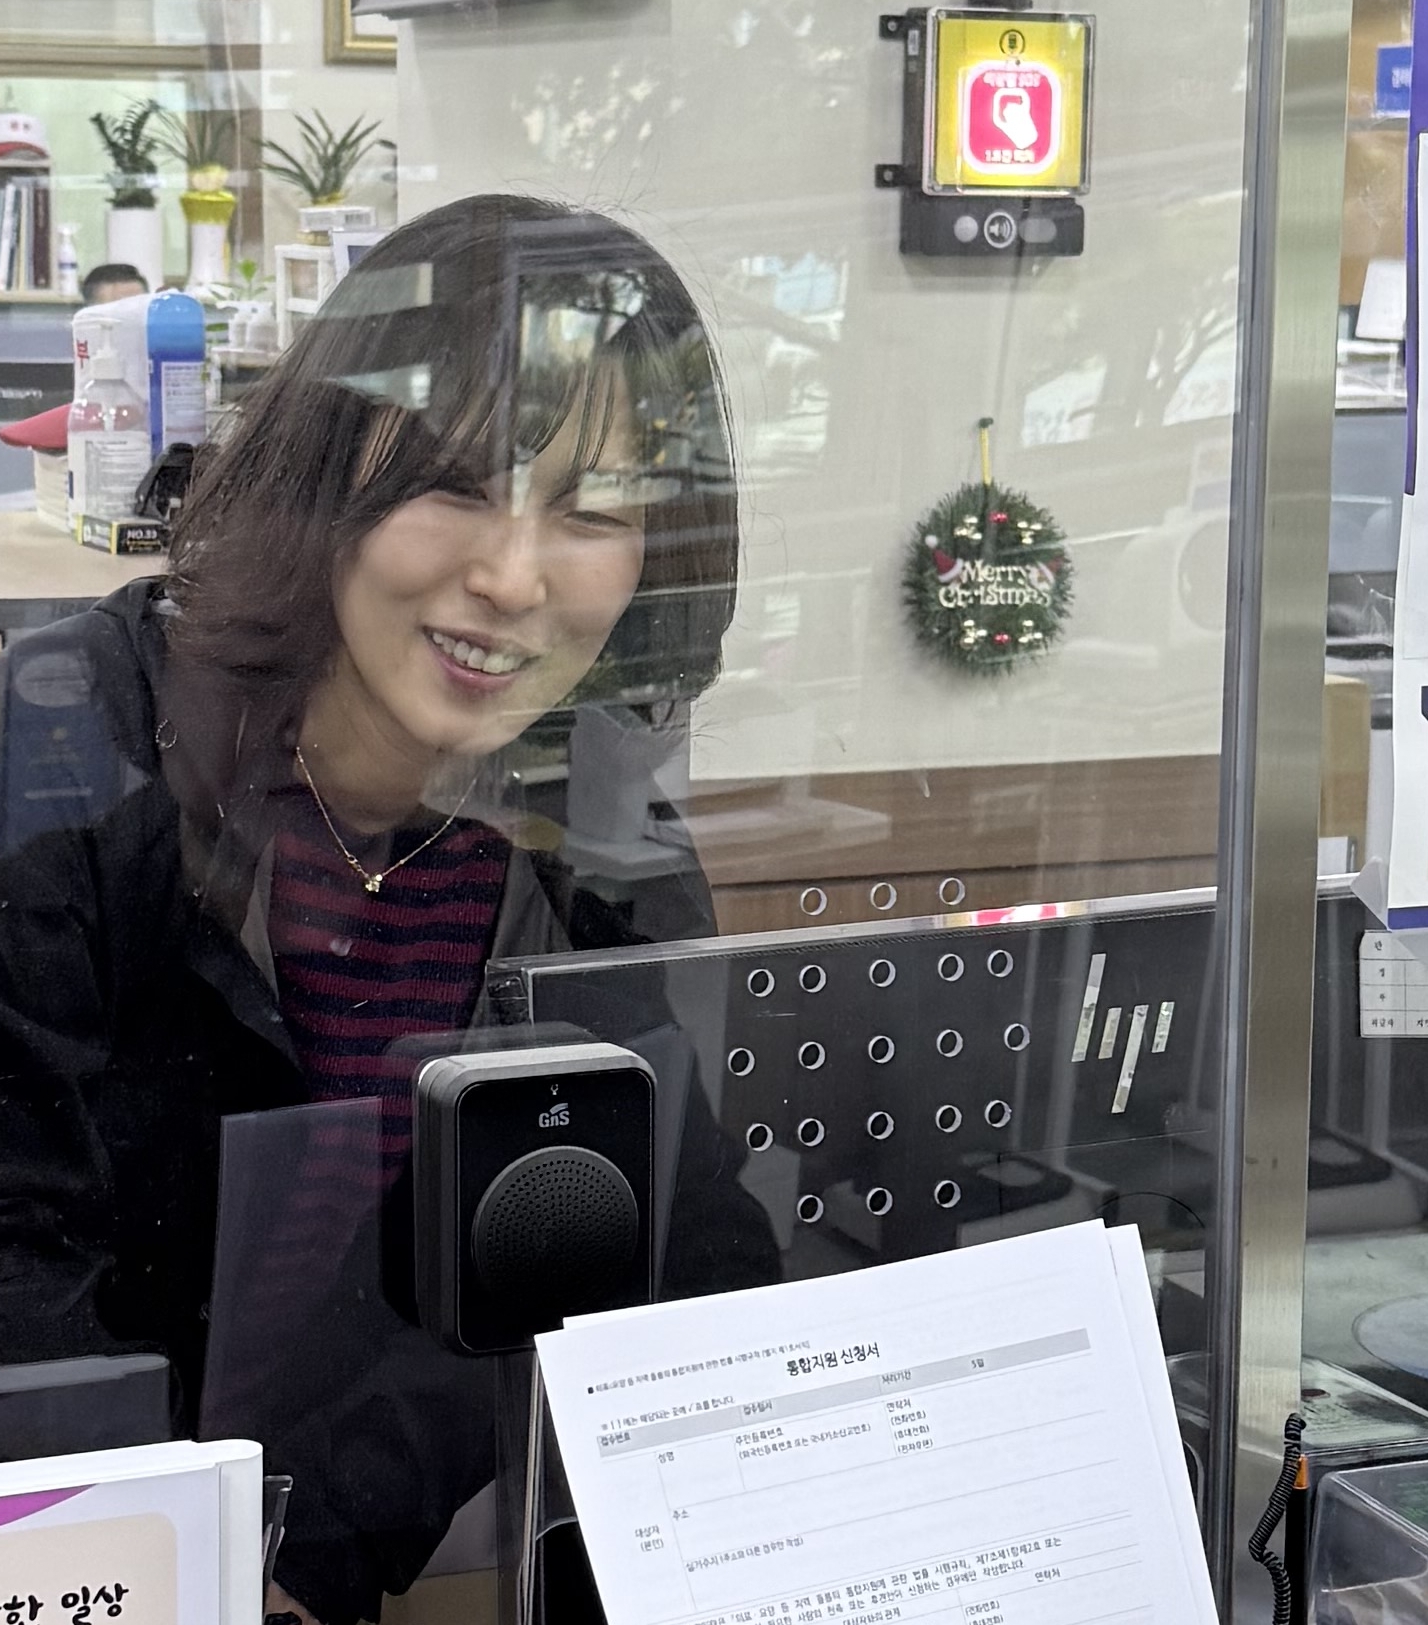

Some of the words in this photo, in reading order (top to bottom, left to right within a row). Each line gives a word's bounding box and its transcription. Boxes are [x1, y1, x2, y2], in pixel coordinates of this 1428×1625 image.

[960, 559, 1029, 585] Merry
[787, 1352, 838, 1376] 통합지원
[841, 1343, 879, 1364] 신청서
[62, 1583, 129, 1624] 일상
